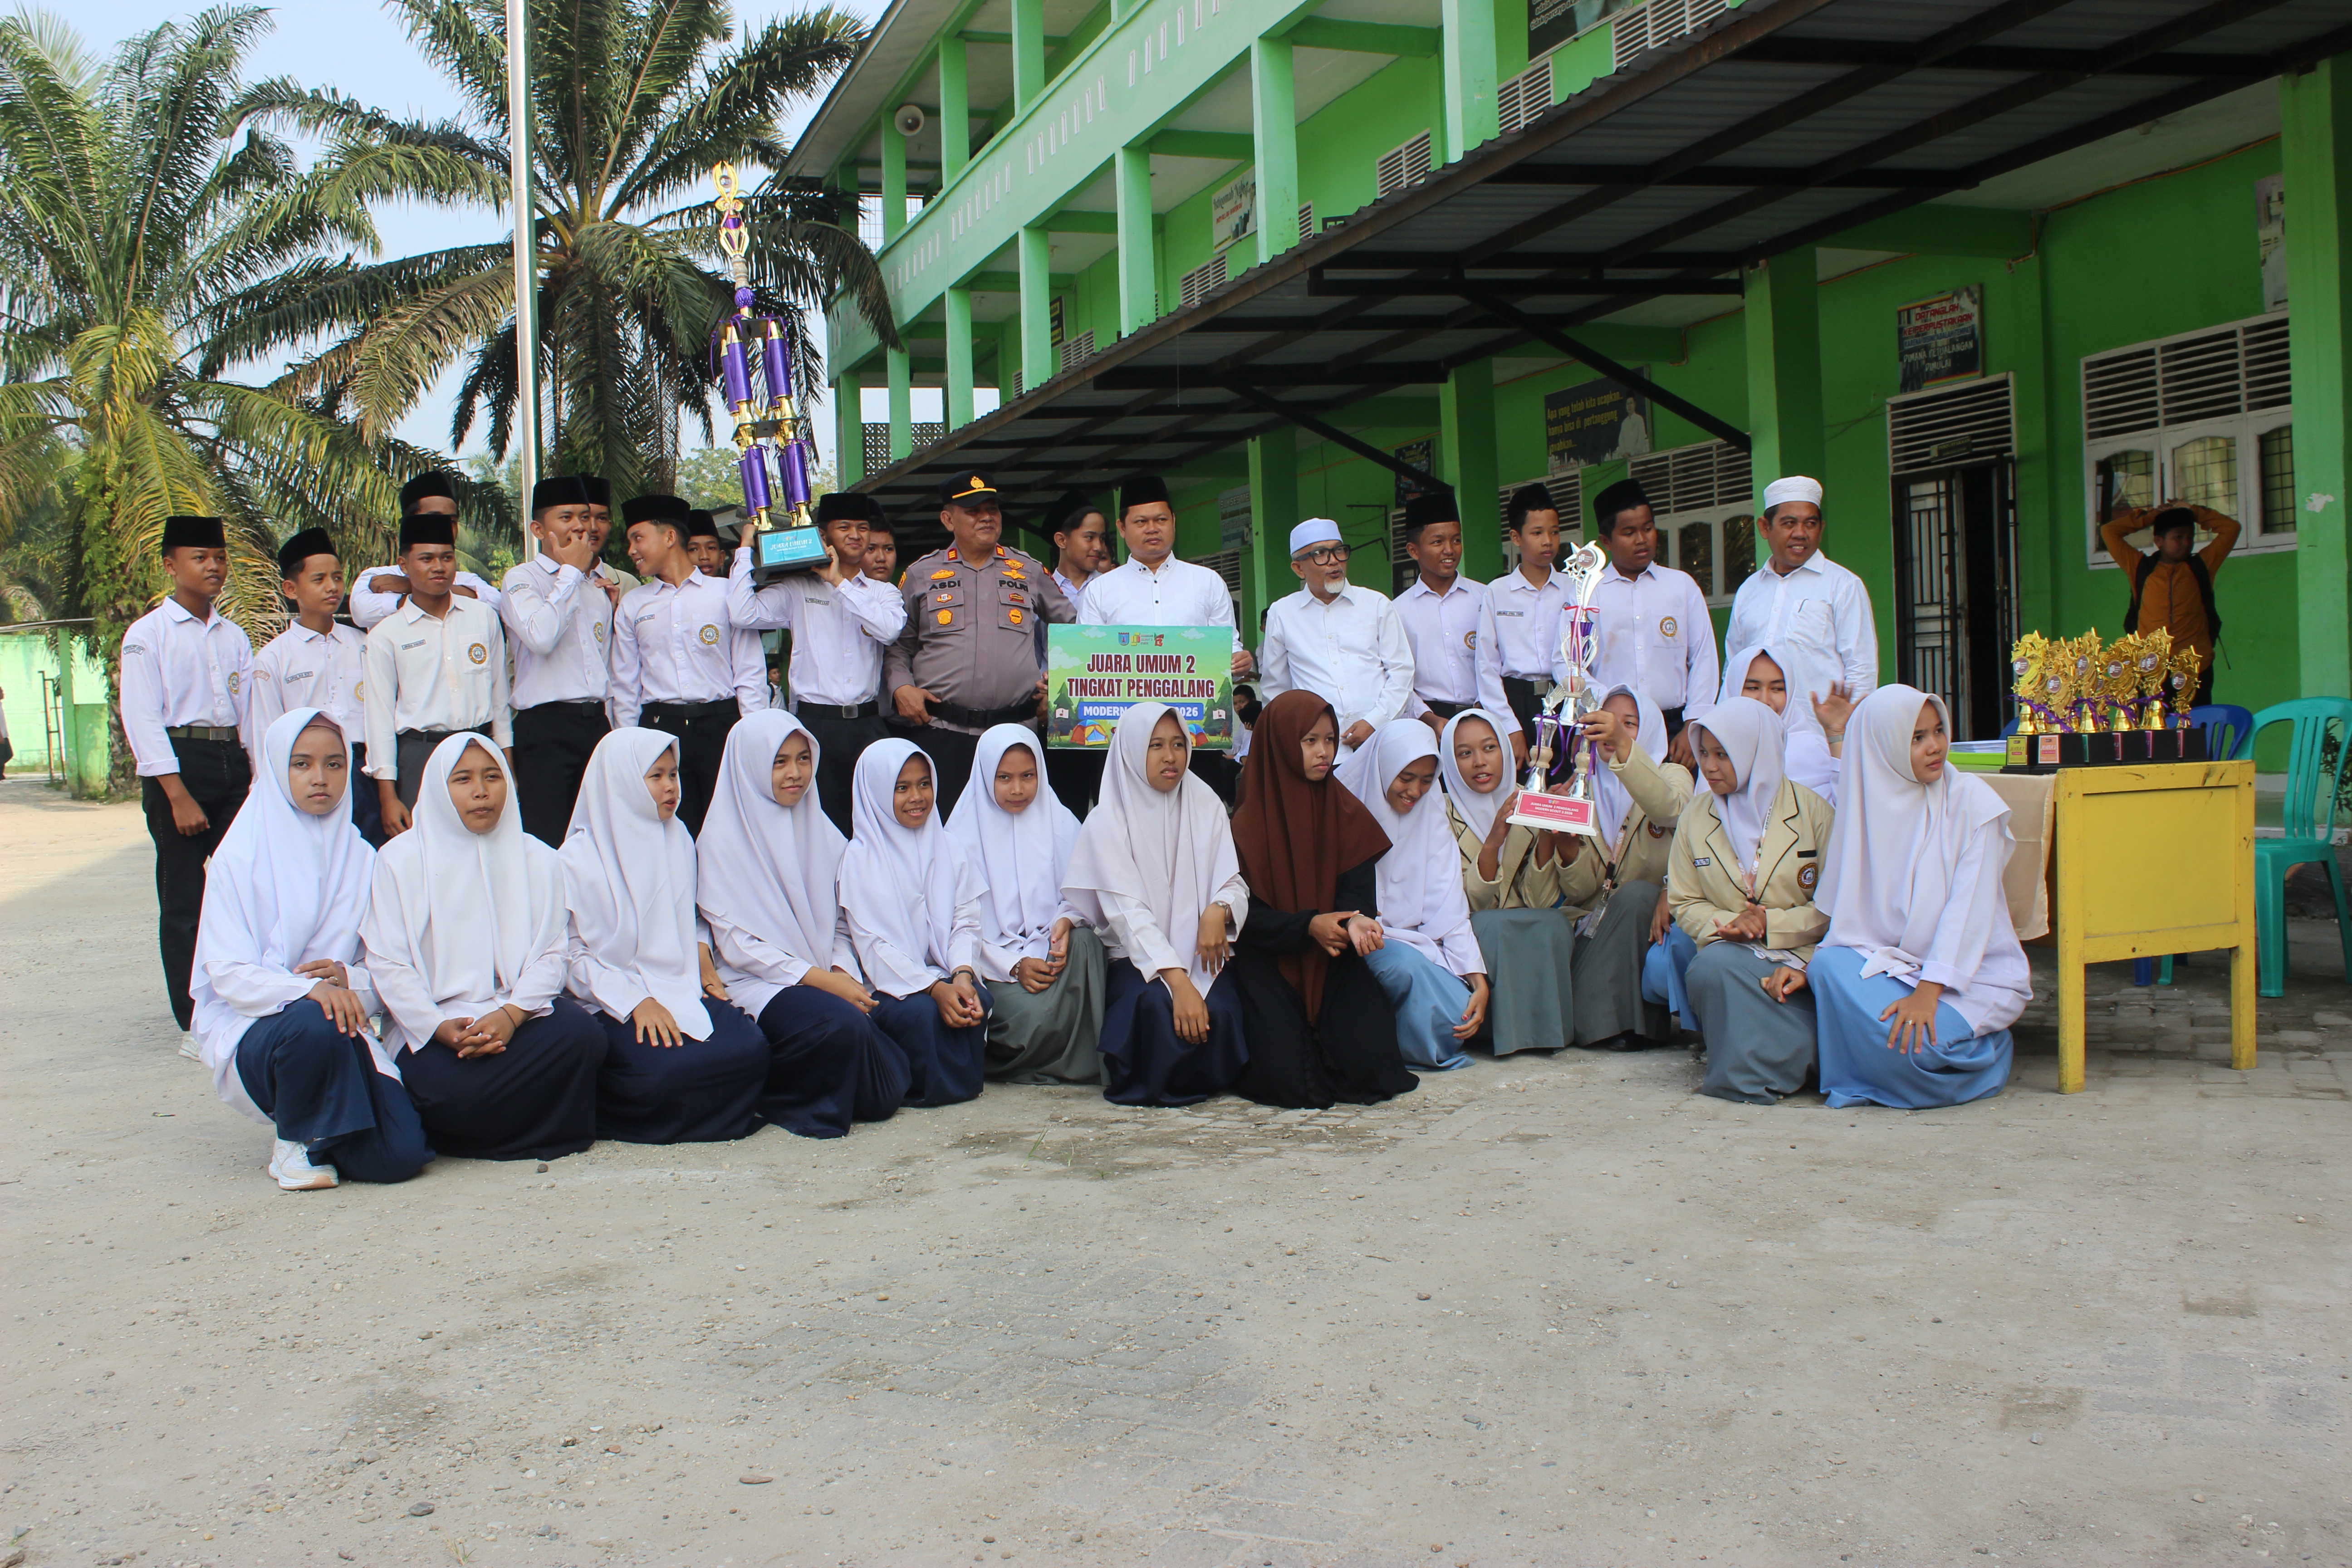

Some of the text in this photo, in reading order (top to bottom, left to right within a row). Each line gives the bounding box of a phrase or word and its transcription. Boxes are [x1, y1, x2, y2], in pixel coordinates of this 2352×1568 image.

[1530, 15, 1545, 30] tidak
[1544, 4, 1566, 24] percaya
[1916, 303, 1959, 321] DATANGLAH
[1903, 313, 1973, 336] KE PERPUSTAKAAN
[1904, 340, 1974, 363] DIMANA PETUALANGAN
[1926, 359, 1951, 372] DIMULAI
[1548, 408, 1557, 421] Apa
[1558, 405, 1571, 419] yang
[1571, 399, 1584, 413] telah
[1586, 396, 1596, 409] kita
[1548, 410, 1618, 436] hanya bisa di pertanggung
[1220, 495, 1240, 509] SUKSES
[929, 580, 961, 591] ASDI
[999, 579, 1029, 592] POLRI
[1087, 654, 1196, 674] JUARA UMUM 2
[1067, 678, 1215, 698] TINGKAT PENGGALANG
[1084, 706, 1127, 716] MODERN
